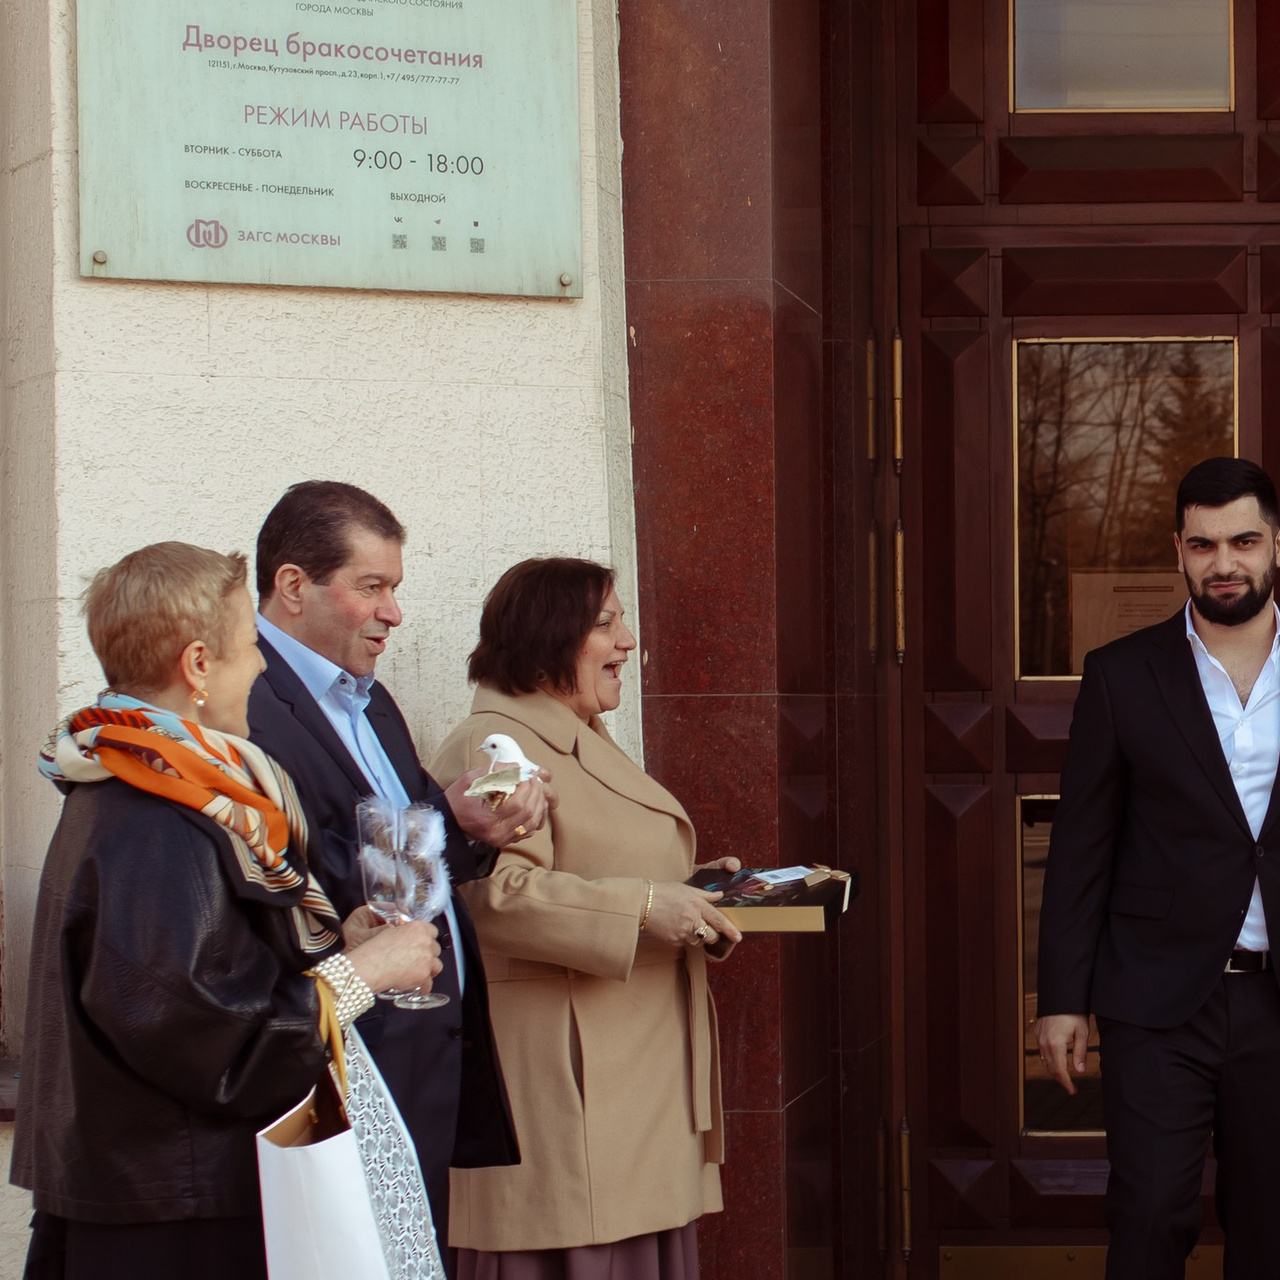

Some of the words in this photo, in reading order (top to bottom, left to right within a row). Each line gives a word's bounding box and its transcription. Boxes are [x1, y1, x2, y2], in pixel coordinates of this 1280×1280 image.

[296, 3, 332, 13] ГОРОДА
[334, 6, 373, 16] МОСКВЫ
[183, 25, 278, 57] Дворец
[286, 32, 482, 68] бракосочетания
[245, 105, 330, 128] РЕЖИМ
[340, 111, 427, 135] РАБОТЫ
[185, 145, 229, 155] ВТОРНИК
[238, 148, 282, 158] СУББОТА
[354, 149, 402, 170] 9:00
[428, 154, 483, 175] 18:00
[185, 180, 252, 192] ВОСКРЕСЕНЬЕ
[262, 185, 334, 196] ПОНЕДЕЛЬНИК
[391, 193, 445, 203] ВЫХОДНОЙ
[238, 230, 272, 242] ЗАГС
[277, 233, 340, 246] МОСКВЫ
